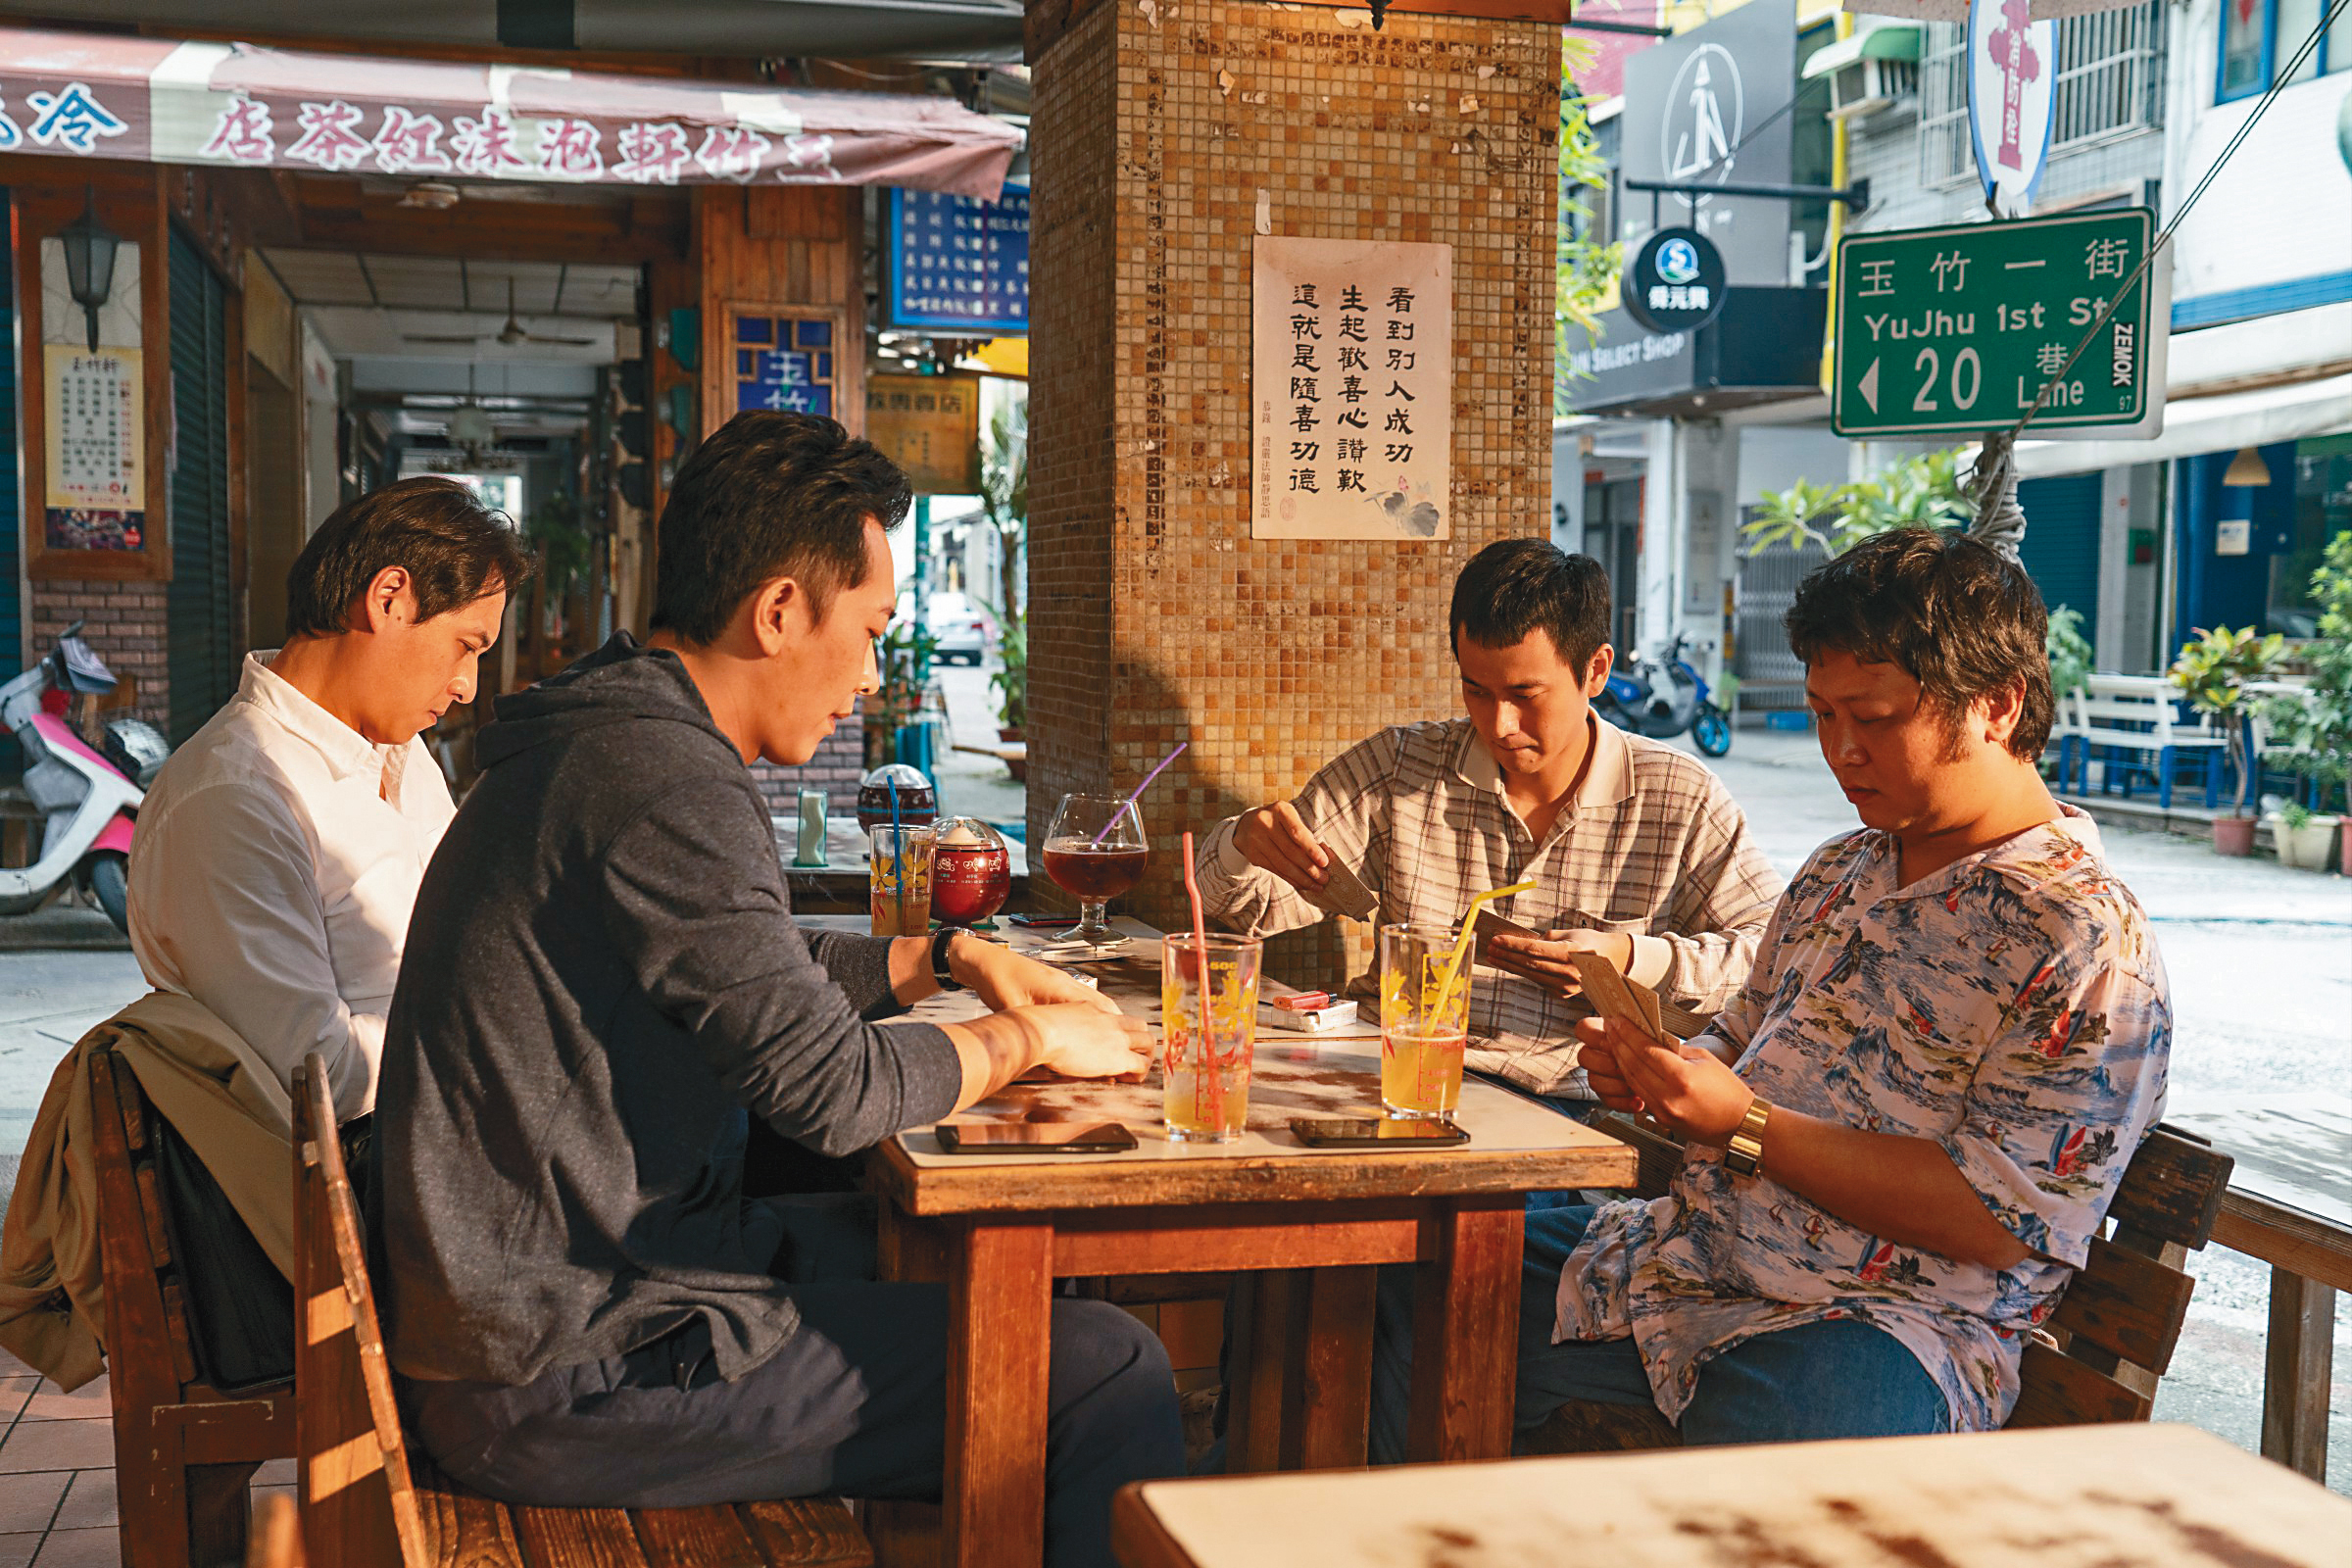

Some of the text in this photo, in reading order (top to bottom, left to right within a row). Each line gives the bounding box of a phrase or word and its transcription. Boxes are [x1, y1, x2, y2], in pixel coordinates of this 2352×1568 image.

[1858, 238, 2130, 298] 玉竹一街
[1865, 309, 1976, 342] YuJhu
[1997, 301, 2046, 332] 1st
[1385, 286, 1416, 464] 看到別人成功
[1913, 347, 1982, 412] 20
[2035, 342, 2070, 376] 巷
[2112, 322, 2134, 387] ZEMOK
[1289, 283, 1322, 495] 這就是隨喜功德
[1337, 284, 1369, 494] 生起歡喜心讚歎
[2017, 375, 2084, 410] Lane
